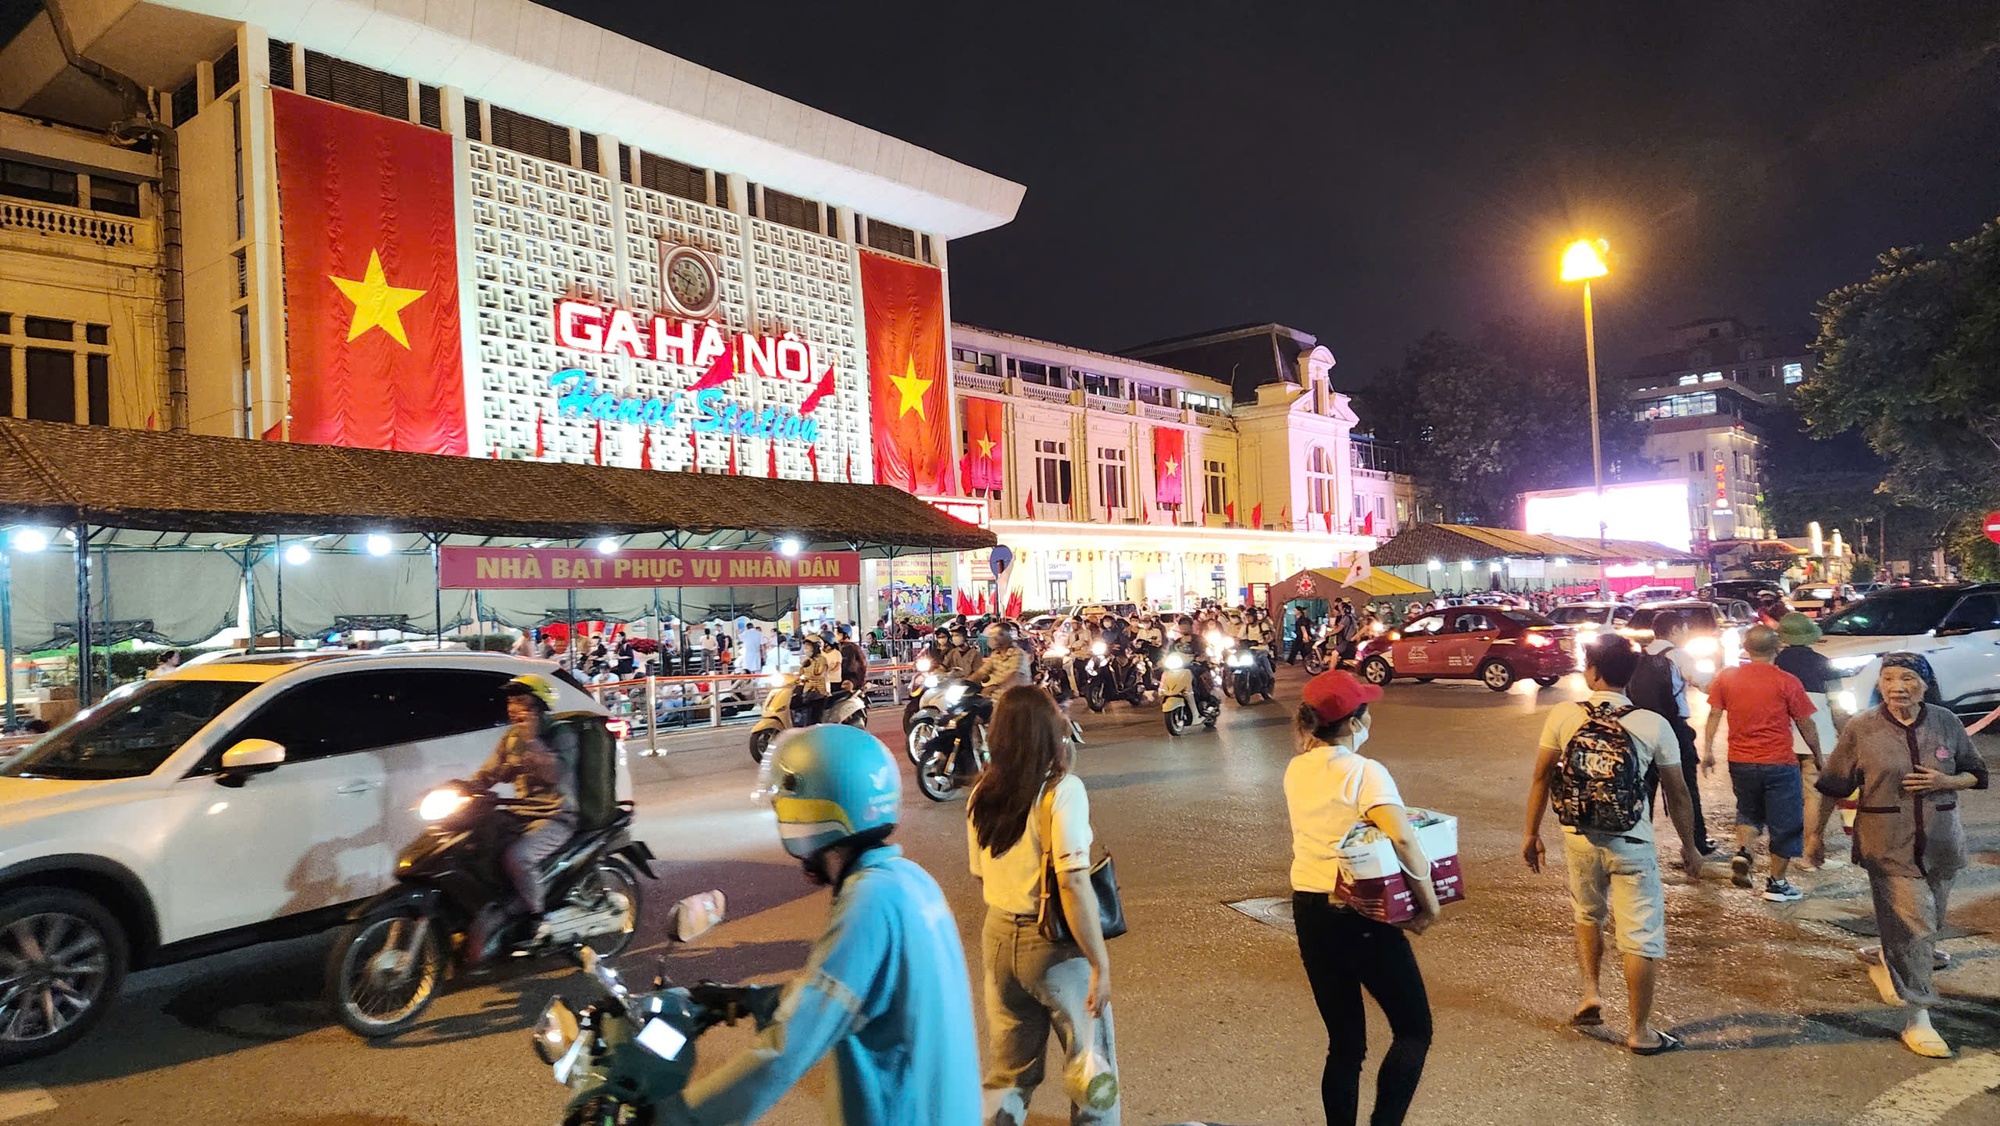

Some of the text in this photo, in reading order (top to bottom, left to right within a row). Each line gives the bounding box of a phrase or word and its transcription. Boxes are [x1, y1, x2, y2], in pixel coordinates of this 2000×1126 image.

[557, 300, 647, 357] GA
[654, 318, 726, 367] HÀ
[550, 368, 820, 443] Hanoi Station
[476, 554, 839, 583] NHÀ BẠT PHỤC VỤ NHÂN DÂN
